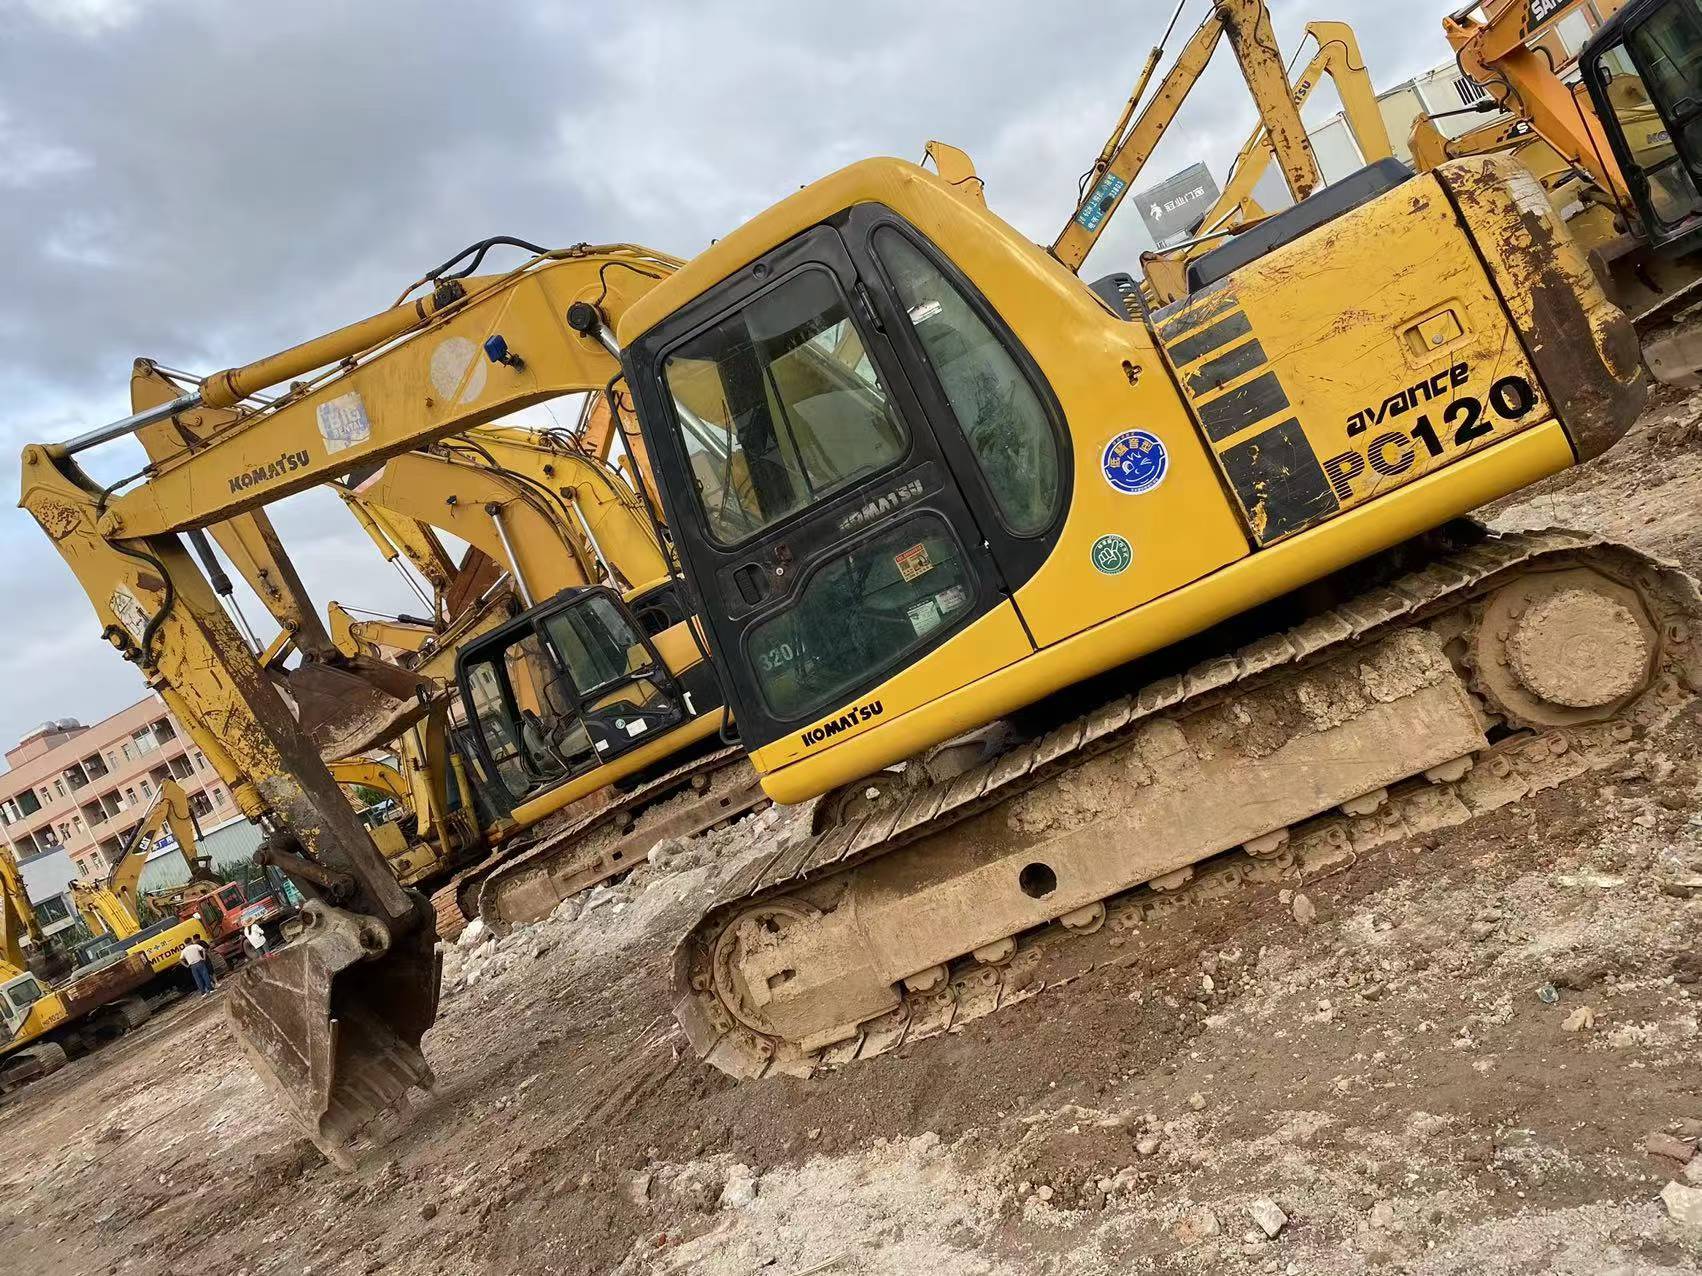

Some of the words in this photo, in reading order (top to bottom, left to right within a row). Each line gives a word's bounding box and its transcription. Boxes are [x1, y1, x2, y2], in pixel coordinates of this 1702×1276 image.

[1346, 361, 1469, 438] avance
[1322, 375, 1539, 501] PC120
[228, 450, 310, 494] KOMATSU
[840, 480, 923, 530] KOMATSU
[801, 700, 884, 747] KOMATSU
[146, 943, 186, 966] MITOMO
